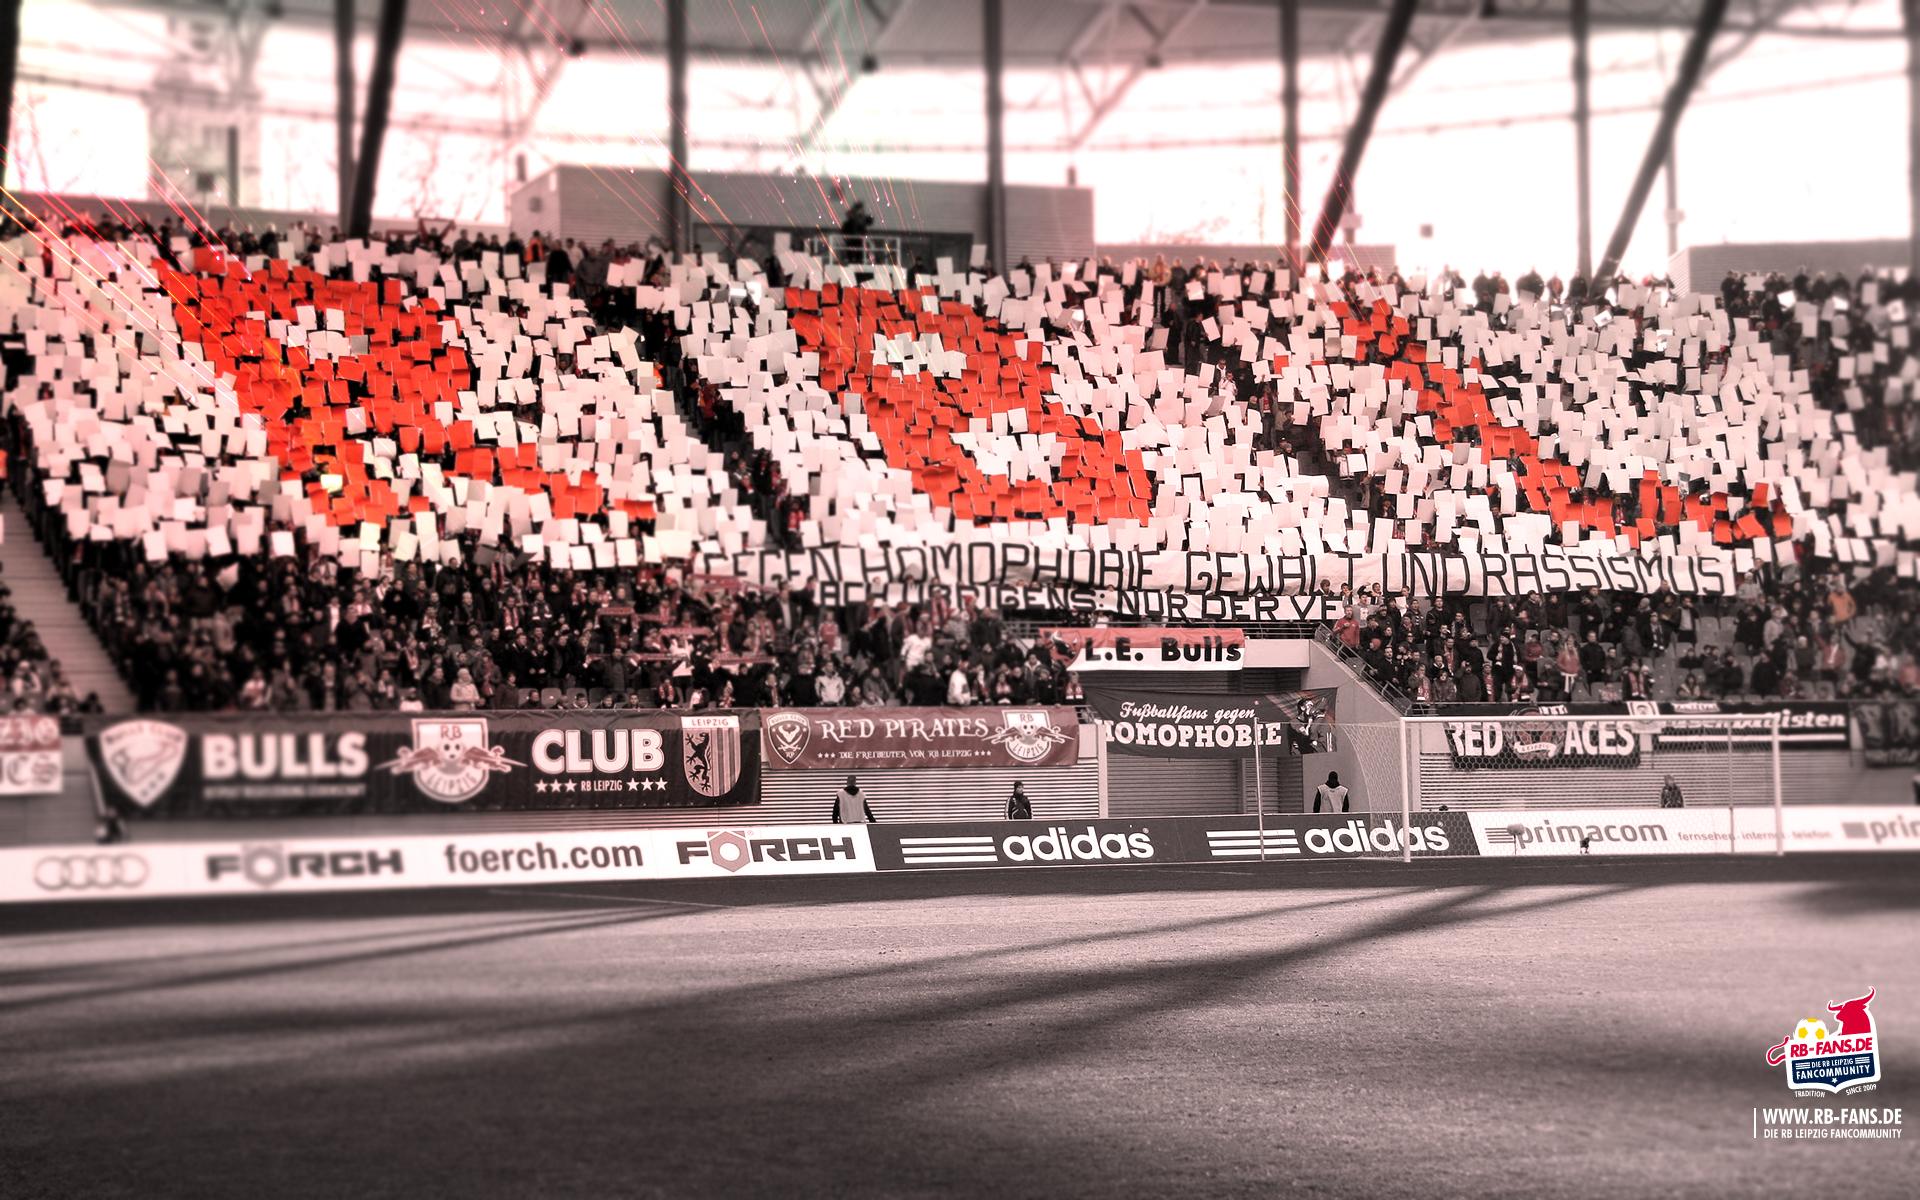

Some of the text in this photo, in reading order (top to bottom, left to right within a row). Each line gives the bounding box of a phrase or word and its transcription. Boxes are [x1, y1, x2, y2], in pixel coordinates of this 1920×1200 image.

[1185, 551, 1362, 596] GEWALT
[1381, 551, 1470, 597] UND
[1481, 553, 1725, 596] RASSISMUS
[1085, 635, 1241, 661] L.E. Bulls
[691, 718, 729, 726] LEIPZIG
[1120, 701, 1255, 724] Fußballfans gegen
[815, 718, 875, 743] RED
[880, 718, 988, 742] PIRATES
[1448, 720, 1635, 756] RED ACES
[203, 732, 368, 778] BULLS
[532, 728, 665, 774] CLUB
[839, 751, 853, 759] DIE
[942, 749, 972, 758] LEIPZIG
[580, 778, 623, 792] RB LEIPZIG
[1002, 826, 1155, 861] adidas
[1304, 819, 1450, 854] adidas
[1516, 819, 1668, 849] primacom
[444, 841, 644, 874] foerch.com
